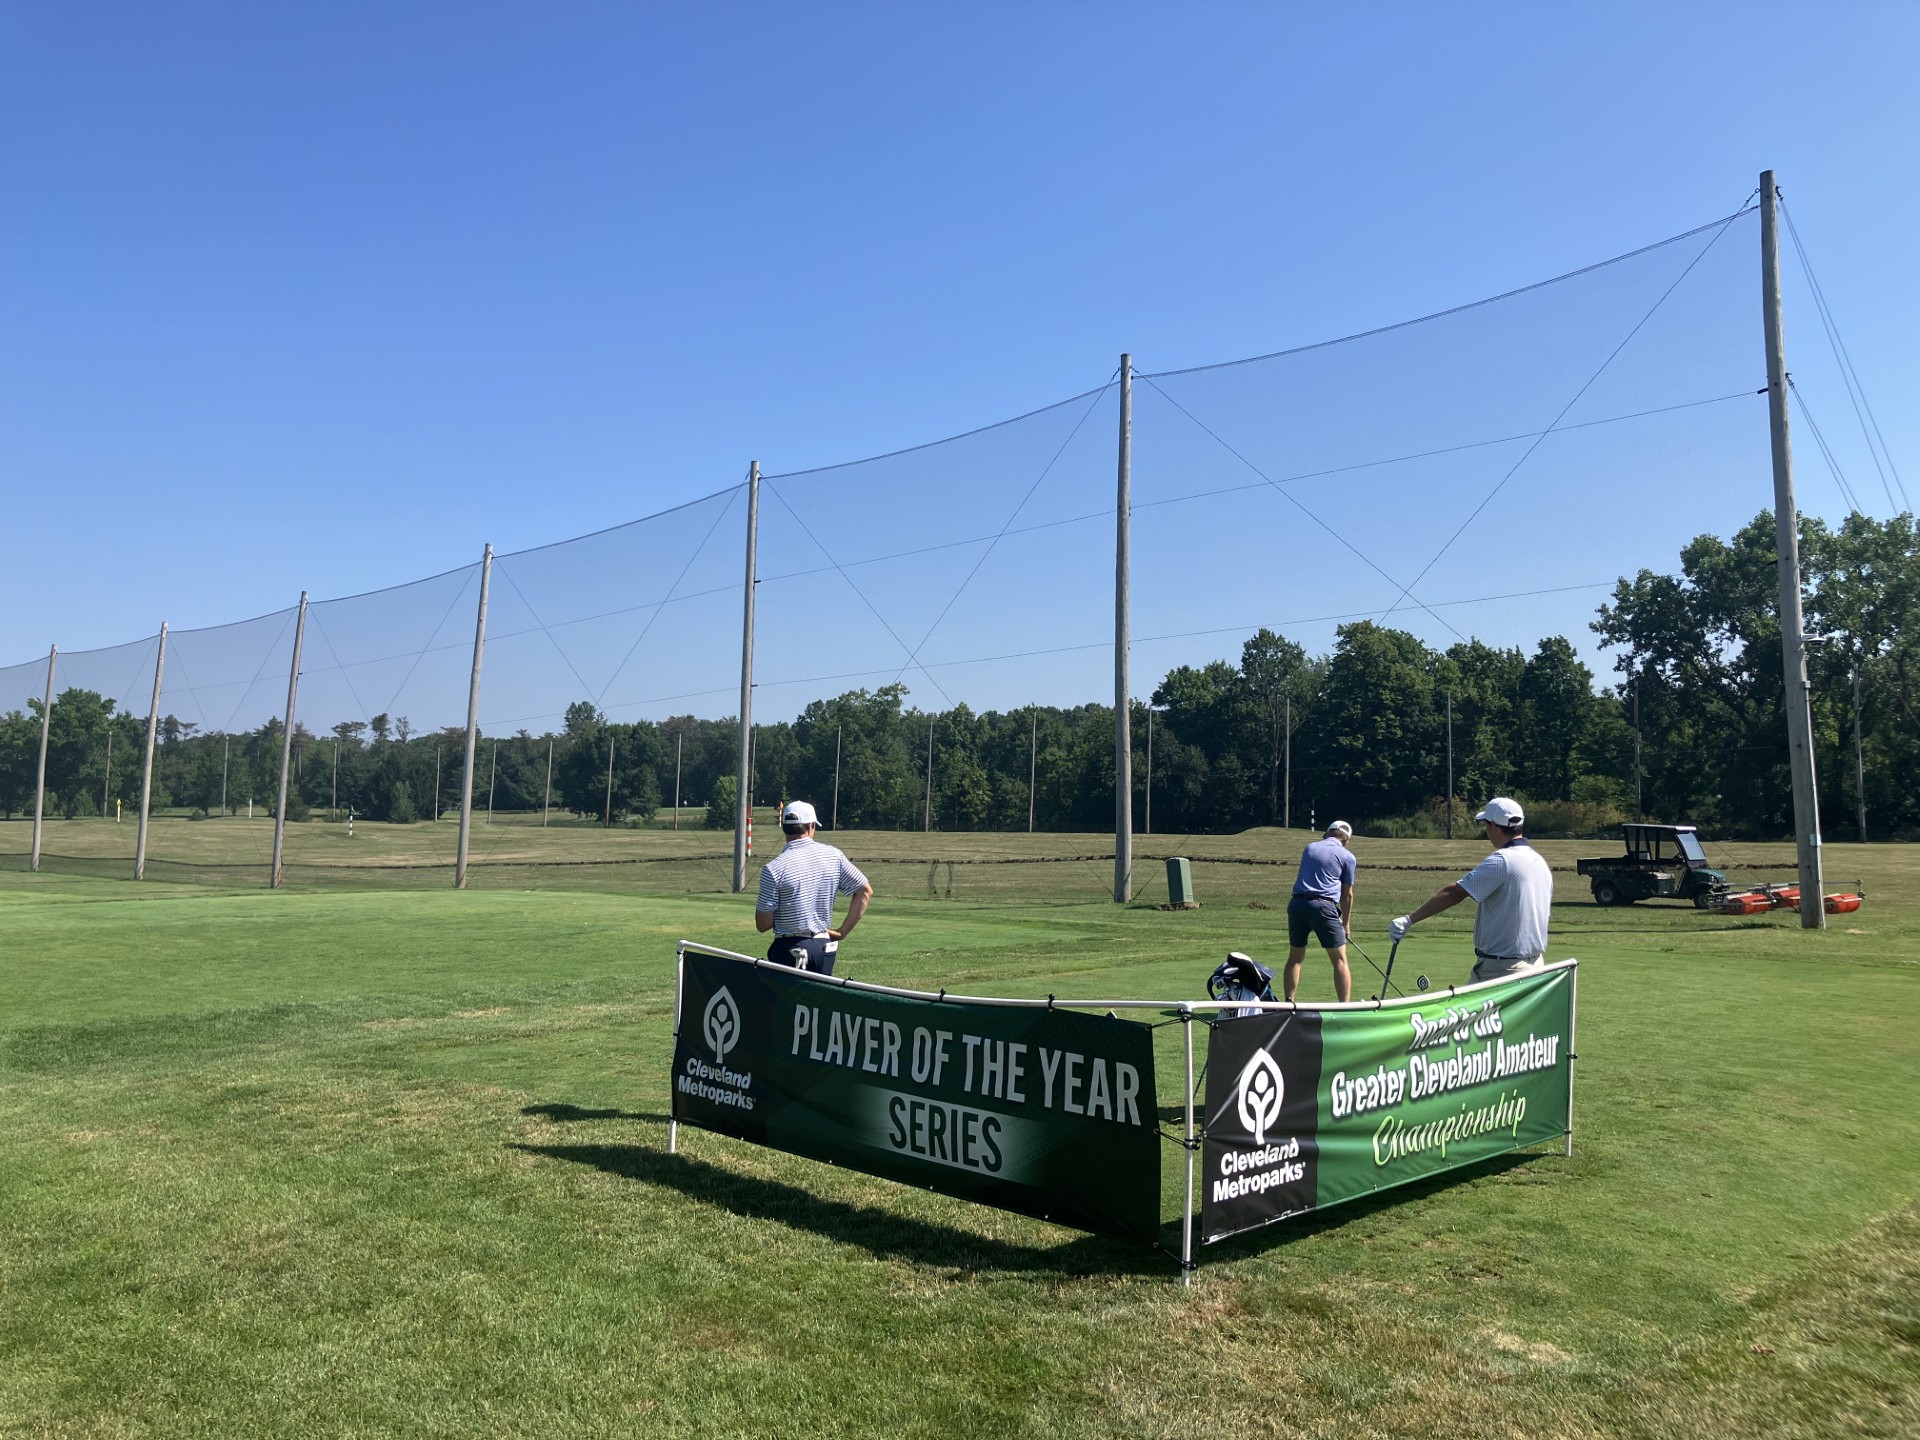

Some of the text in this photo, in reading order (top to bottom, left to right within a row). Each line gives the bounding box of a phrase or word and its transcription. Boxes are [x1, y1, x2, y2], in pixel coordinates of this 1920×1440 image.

[678, 1074, 754, 1110] Metroparks
[686, 1057, 752, 1089] Cleveland
[792, 1004, 1142, 1127] PLAYER OF THE YEAR
[1331, 1034, 1560, 1117] Greater Cleveland Amateur
[888, 1095, 1003, 1174] SERIES
[1220, 1137, 1299, 1176] Cleveland
[1372, 1089, 1526, 1166] Championship
[1213, 1163, 1304, 1203] Metroparks
